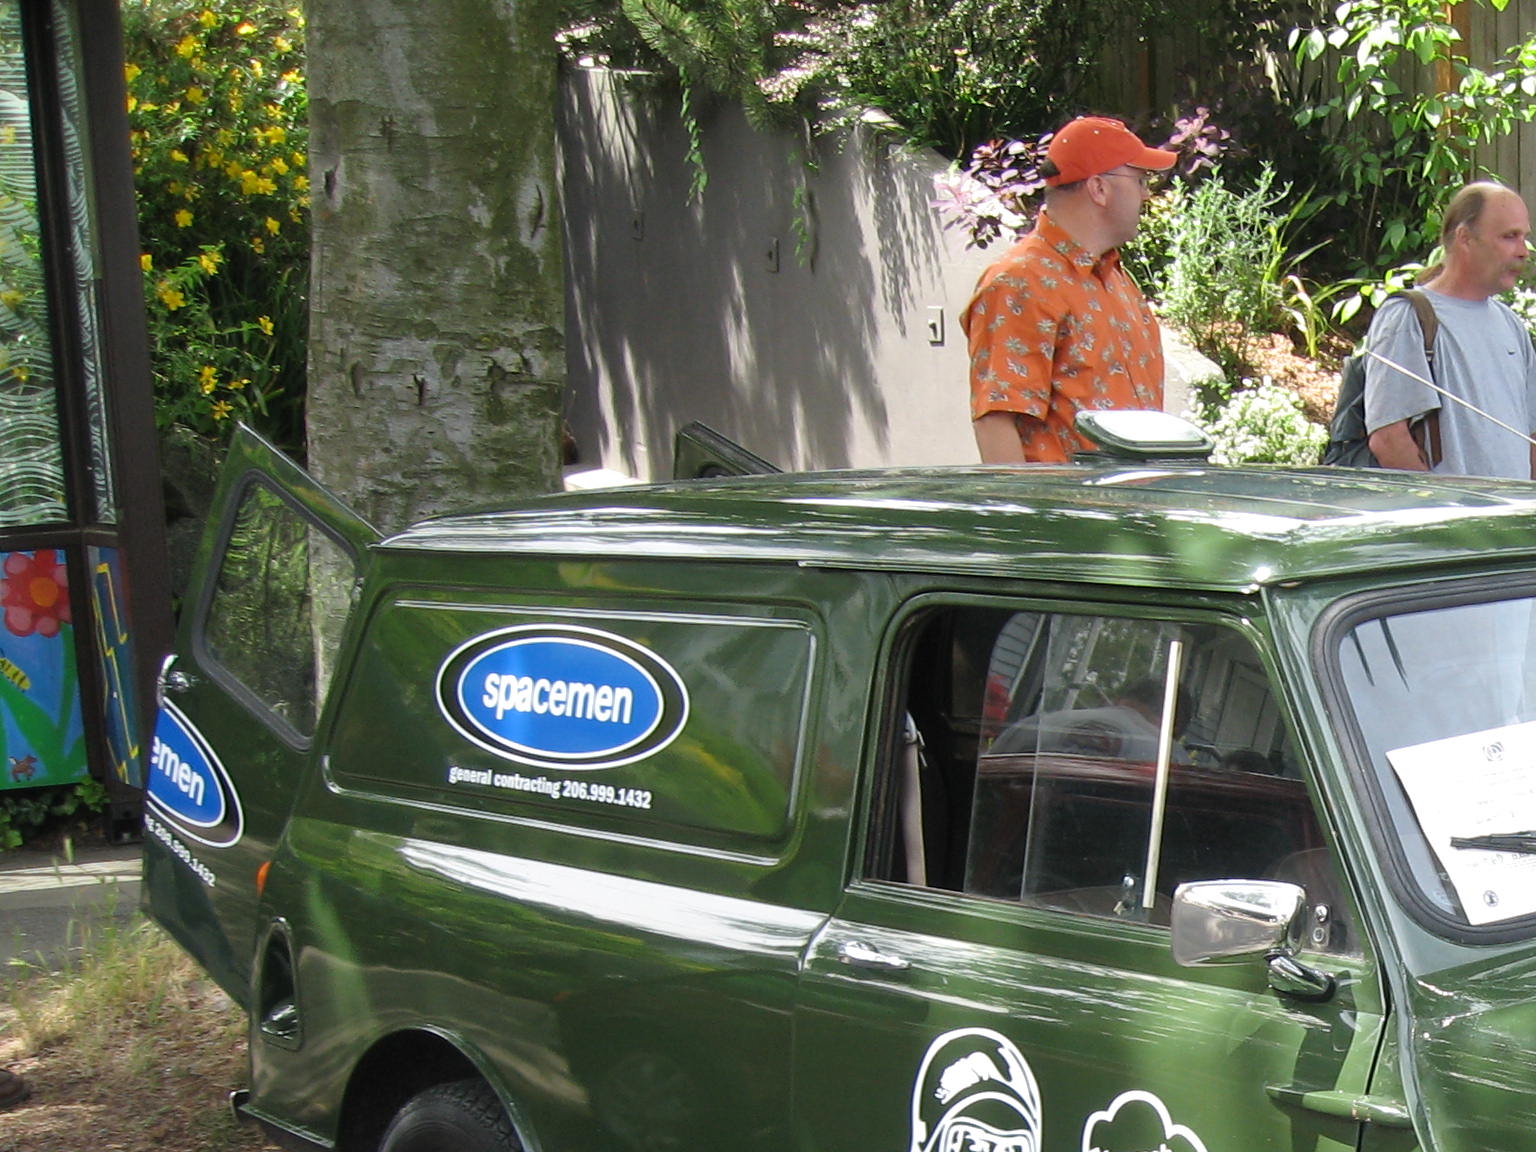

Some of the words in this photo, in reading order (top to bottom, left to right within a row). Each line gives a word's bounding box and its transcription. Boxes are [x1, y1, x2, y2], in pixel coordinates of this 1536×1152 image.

[482, 672, 633, 724] spacemen
[448, 766, 492, 785] general
[494, 773, 561, 798] contracting
[562, 780, 652, 809] 206.999.1432
